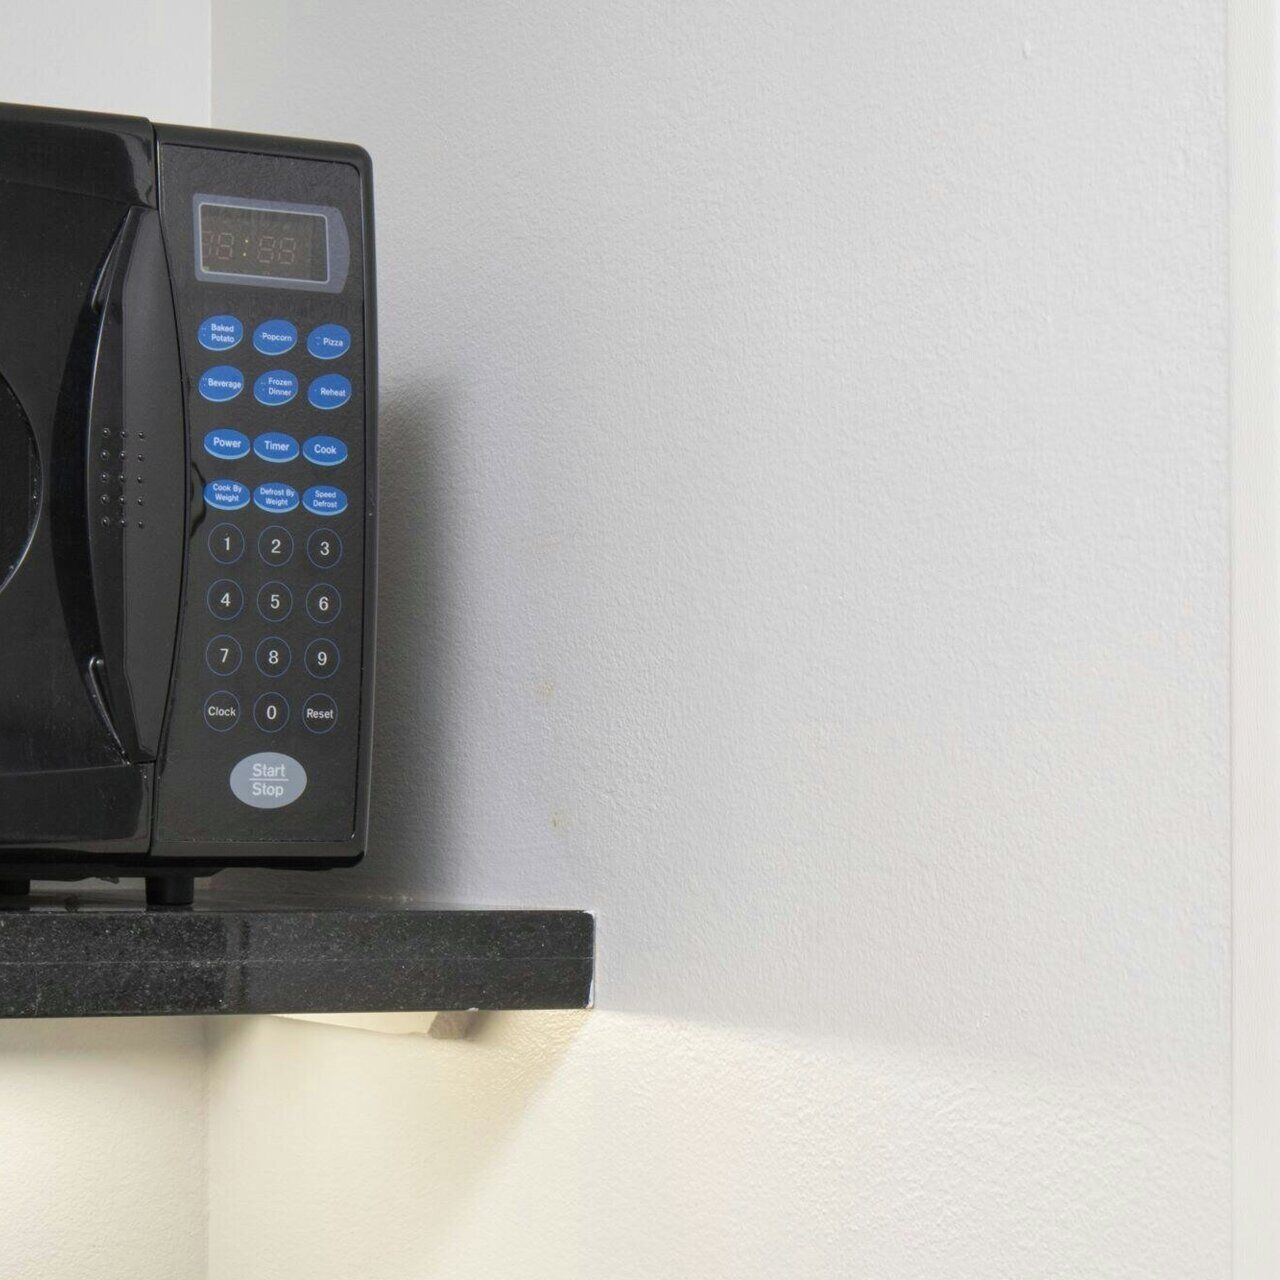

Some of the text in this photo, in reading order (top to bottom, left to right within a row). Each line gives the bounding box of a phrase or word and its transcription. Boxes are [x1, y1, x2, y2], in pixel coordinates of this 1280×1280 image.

[211, 324, 235, 333] Baked
[211, 334, 236, 344] Potato
[262, 332, 293, 343] Popcorn
[323, 337, 344, 348] Pizza
[208, 378, 242, 390] Beverage
[268, 378, 293, 387] Frozen
[268, 388, 292, 397] Dinner
[320, 387, 346, 398] Reheat
[213, 436, 242, 449] Power
[264, 440, 290, 453] Timer
[314, 443, 338, 456] Cook
[212, 483, 242, 495] Cook By
[259, 486, 295, 500] Defrost By
[314, 490, 337, 500] Speed
[215, 493, 240, 504] Weight
[265, 498, 288, 508] Weight
[312, 499, 337, 510] Defrost
[223, 536, 231, 551] 1
[271, 539, 281, 554] 2
[320, 541, 330, 556] 3
[220, 592, 231, 608] 4
[270, 594, 280, 609] 5
[318, 596, 329, 611] 6
[220, 648, 229, 663] 7
[268, 650, 279, 665] 8
[317, 651, 327, 666] 9
[207, 705, 236, 718] Clock
[266, 705, 277, 720] 0
[306, 707, 334, 720] Reset
[252, 762, 285, 778] Start
[252, 782, 284, 797] Stop
